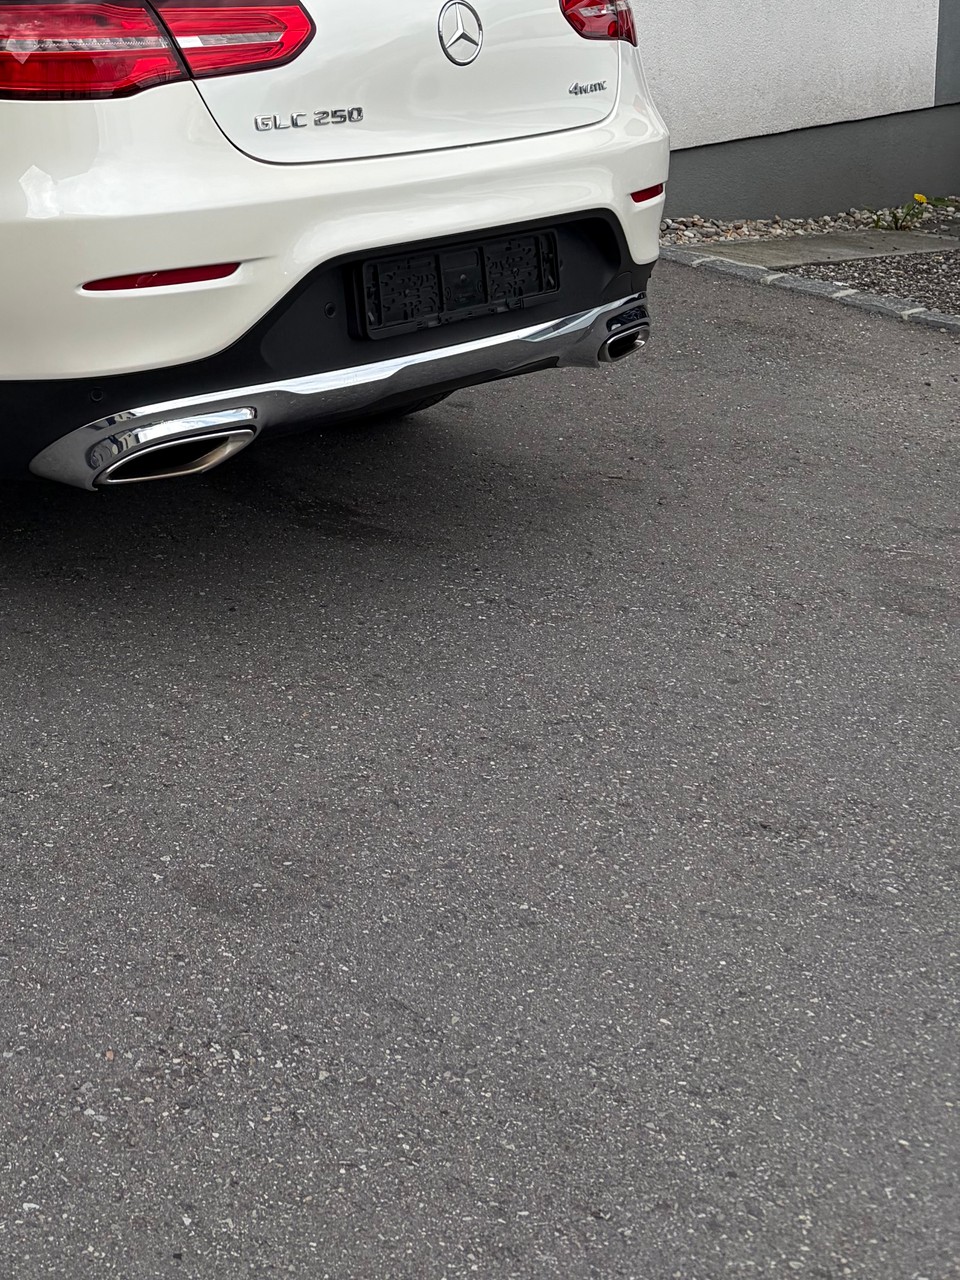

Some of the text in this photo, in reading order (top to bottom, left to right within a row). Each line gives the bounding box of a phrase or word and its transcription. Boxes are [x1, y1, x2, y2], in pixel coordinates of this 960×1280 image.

[568, 80, 608, 96] 4MATIC
[254, 106, 365, 132] GLC 250
